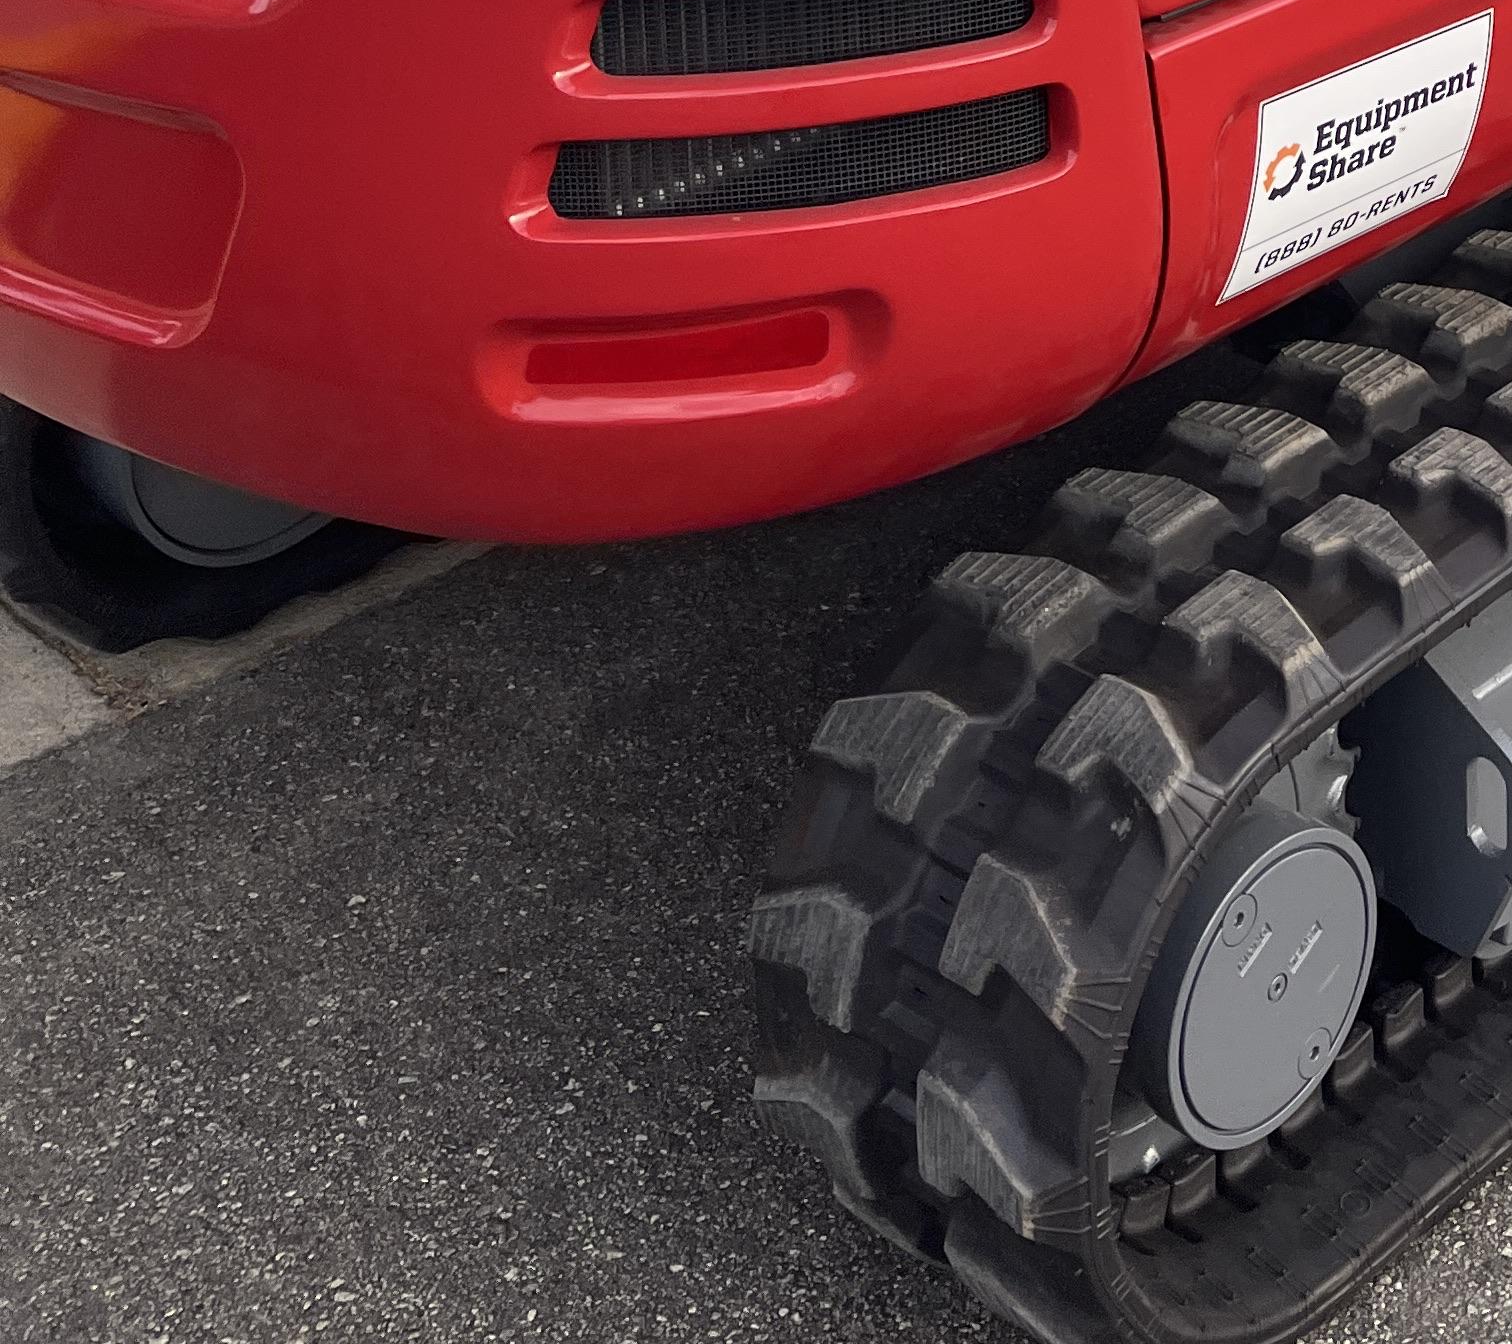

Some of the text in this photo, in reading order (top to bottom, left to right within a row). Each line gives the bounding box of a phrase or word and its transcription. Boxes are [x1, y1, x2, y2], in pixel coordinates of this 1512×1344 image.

[1313, 62, 1478, 155] Equipment
[1307, 135, 1397, 192] Share
[1254, 174, 1438, 274] (888) 80-RENTS
